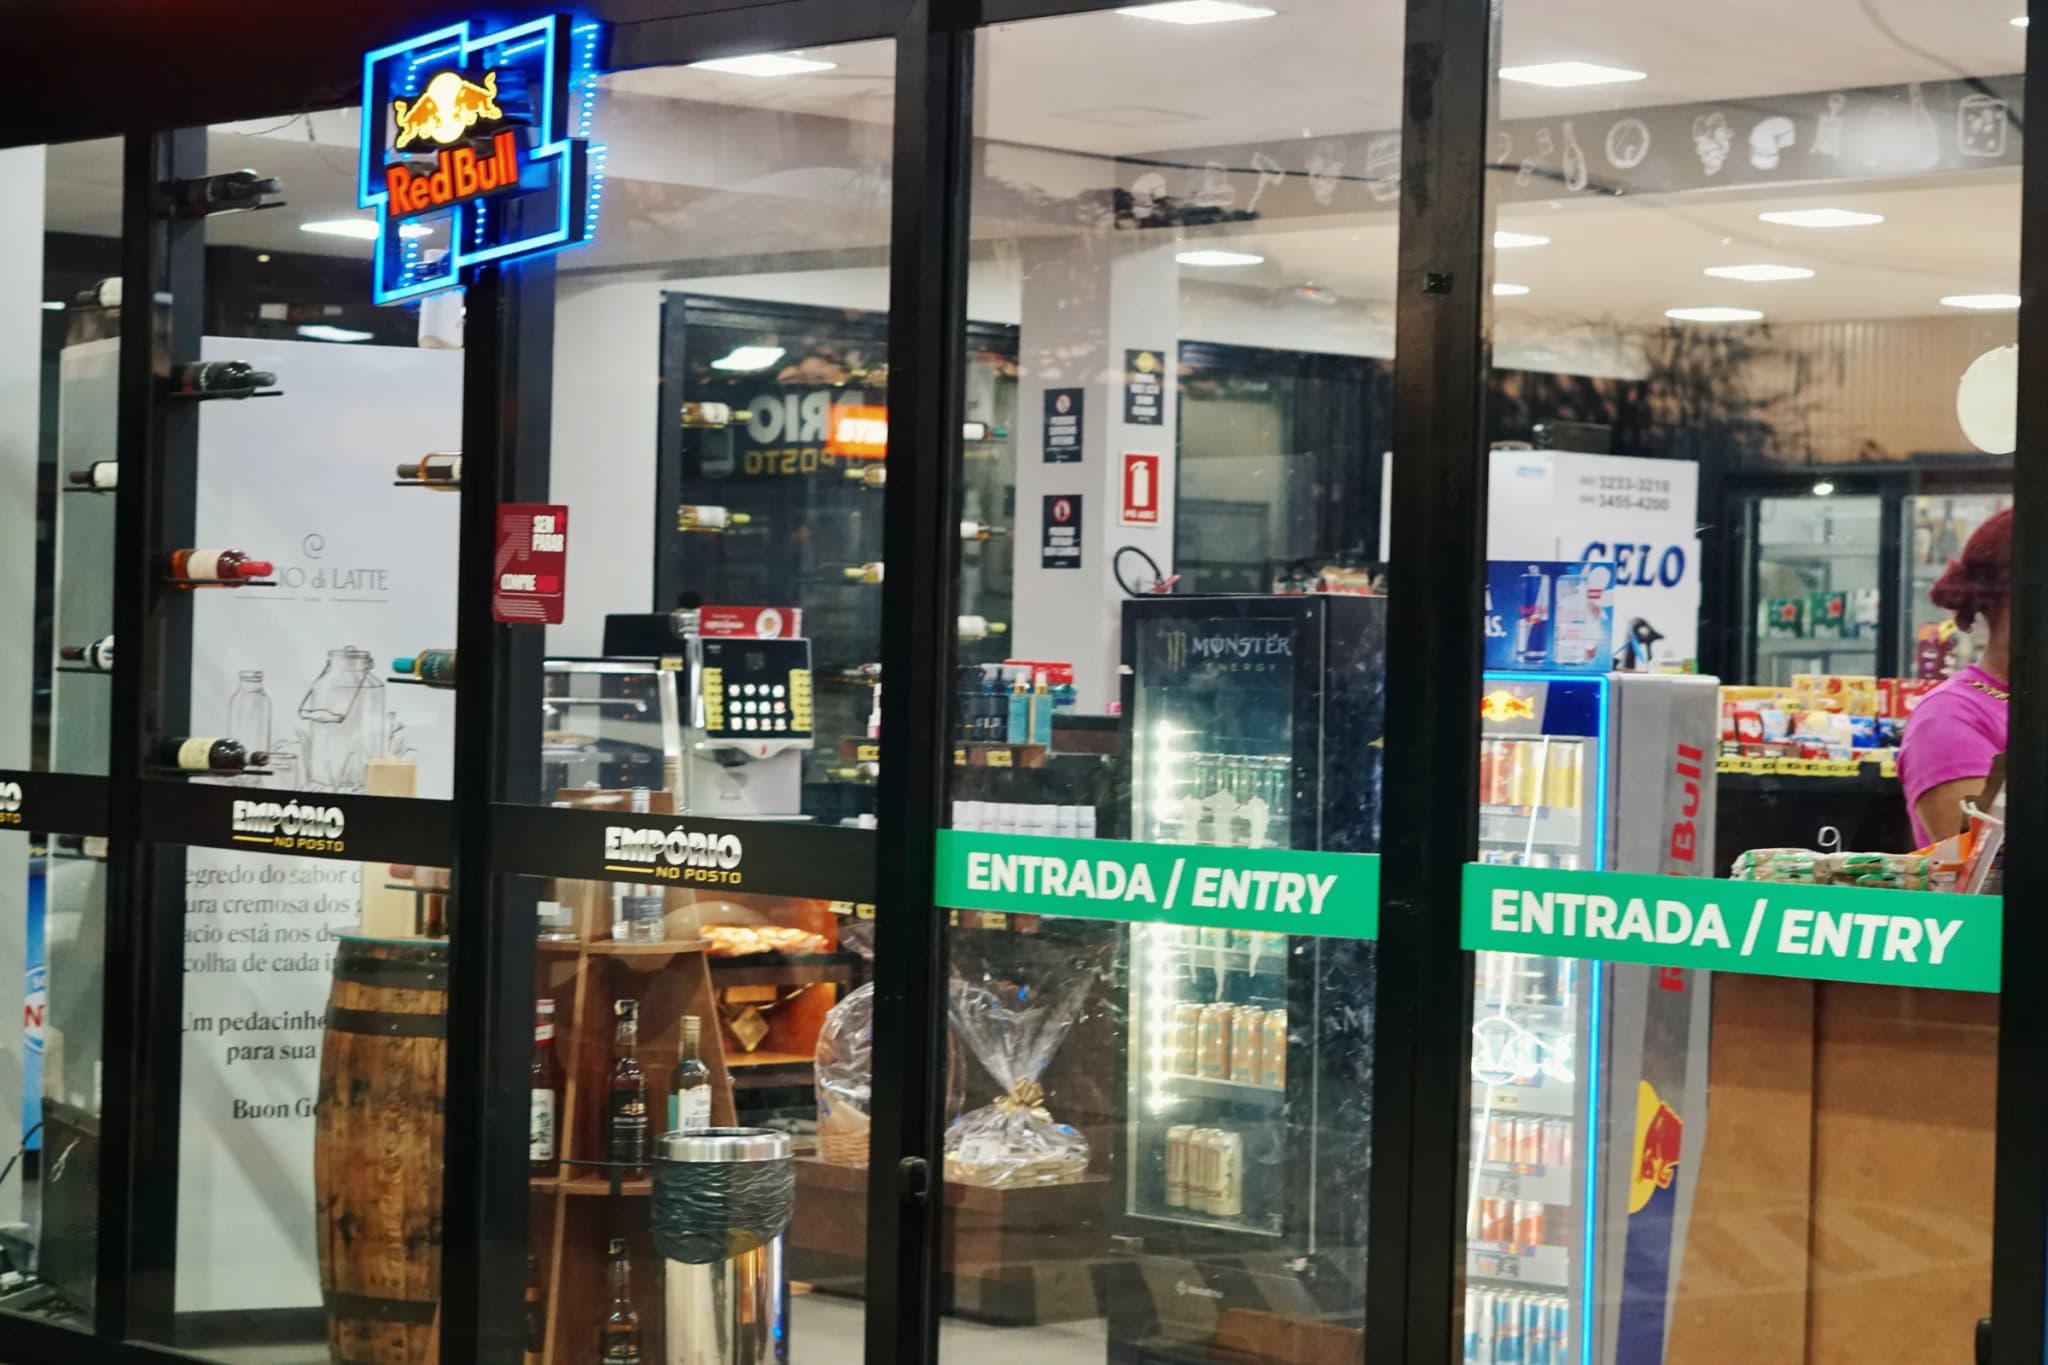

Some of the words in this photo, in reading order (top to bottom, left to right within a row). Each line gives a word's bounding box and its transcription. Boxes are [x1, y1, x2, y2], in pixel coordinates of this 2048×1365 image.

[387, 150, 453, 216] Red
[453, 131, 518, 197] Bull
[311, 568, 326, 590] di
[332, 568, 390, 591] LATTE
[1192, 631, 1294, 658] MONSTER
[1671, 743, 1704, 863] Bull
[232, 798, 345, 839] EMPÓRIO
[274, 836, 294, 848] NO
[297, 838, 345, 852] POSTO
[605, 825, 743, 870] EMPÓRIO
[259, 864, 286, 884] do
[289, 864, 348, 884] sabor
[656, 866, 680, 879] NO
[684, 868, 743, 884] POSTO
[967, 851, 1157, 903] ENTRADA
[1162, 858, 1186, 909] /
[1191, 867, 1339, 915] ENTRY
[223, 899, 309, 914] cremosa
[314, 893, 350, 914] dos
[228, 922, 269, 943] está
[275, 928, 312, 943] nos
[1490, 888, 1732, 949] ENTRADA
[1740, 898, 1768, 957] /
[1777, 908, 1964, 965] ENTRY
[242, 952, 267, 973] de
[271, 952, 319, 973] cada
[226, 1045, 275, 1065] para
[279, 1045, 316, 1060] sua
[232, 1098, 290, 1120] Buon
